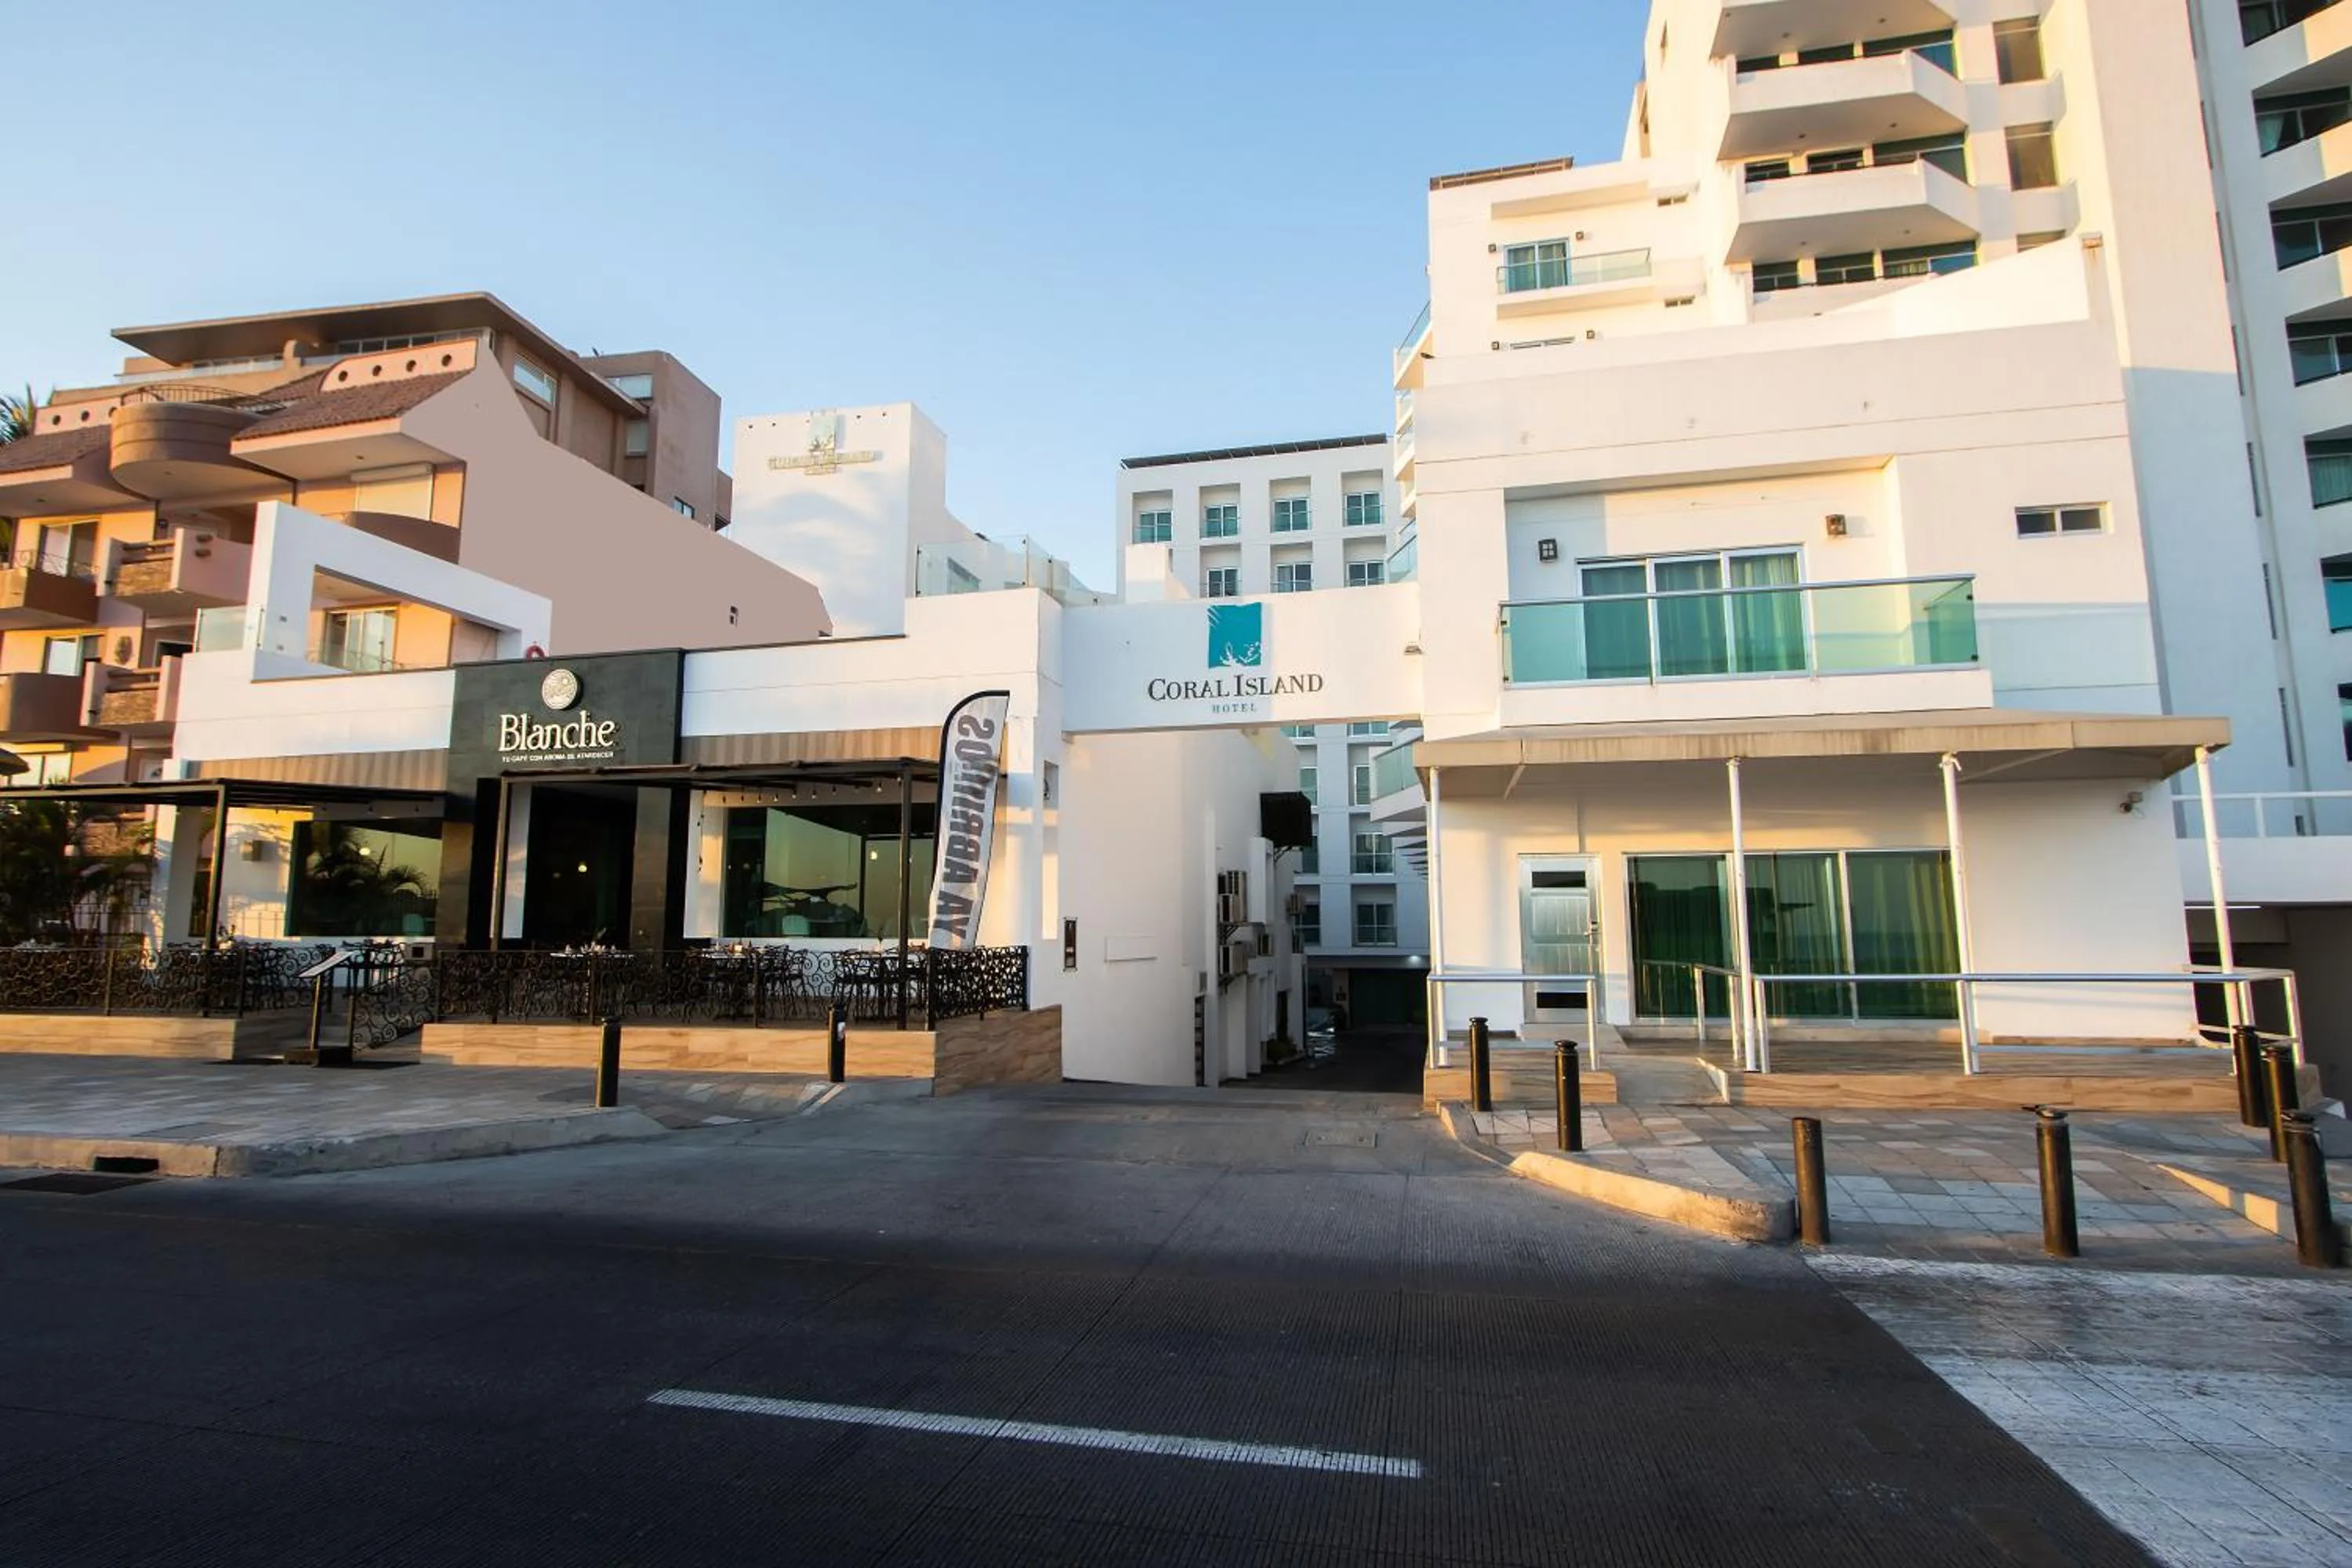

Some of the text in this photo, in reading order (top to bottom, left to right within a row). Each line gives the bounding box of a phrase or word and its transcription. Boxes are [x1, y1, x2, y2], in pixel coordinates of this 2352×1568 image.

[1148, 673, 1323, 701] CORAL ISLAND
[1212, 703, 1257, 713] HOTEL
[499, 710, 615, 752] Blanche
